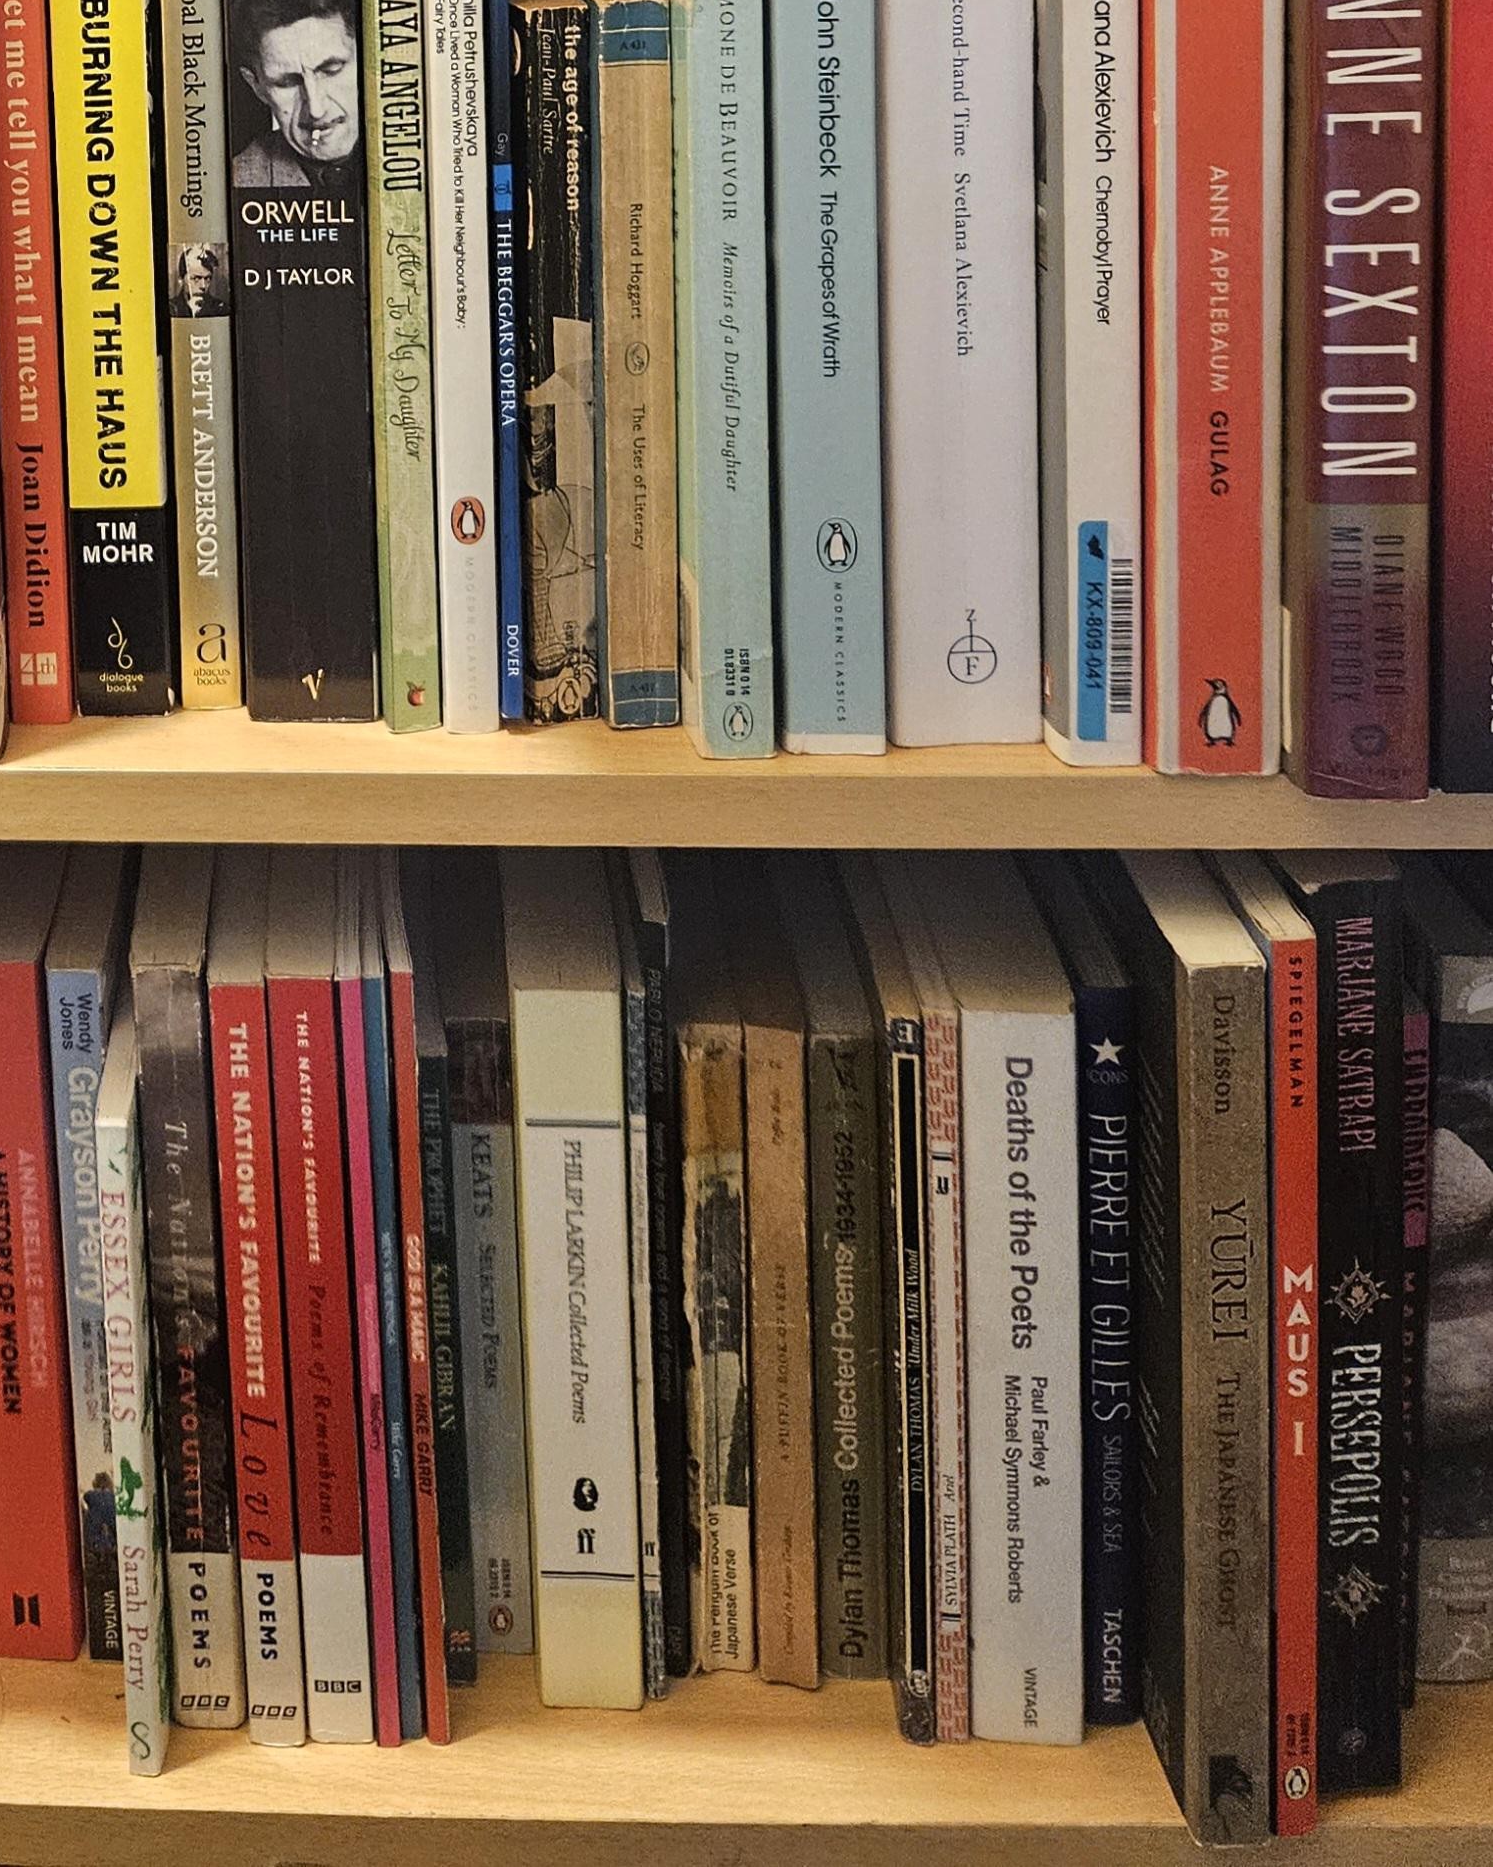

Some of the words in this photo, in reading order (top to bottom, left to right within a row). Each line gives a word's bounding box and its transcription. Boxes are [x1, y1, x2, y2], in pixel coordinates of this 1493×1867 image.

[463, 31, 480, 156] Petrushevskaya
[817, 56, 841, 177] Steinbeck
[1095, 50, 1117, 164] Alexievich
[86, 172, 119, 291] DOWN
[241, 200, 355, 226] ORWELL
[257, 227, 294, 243] THE
[301, 227, 339, 241] LIFE
[1095, 175, 1112, 268] Chernobyl
[244, 270, 260, 286] D
[265, 270, 272, 290] J
[276, 268, 355, 286] TAYLOR
[1095, 270, 1112, 326] Prayer
[92, 302, 123, 378] THE
[1321, 188, 1421, 475] SEXTON
[96, 388, 127, 490] HAUS
[1210, 411, 1229, 496] GULAG
[83, 544, 154, 563] MOHR
[97, 521, 136, 541] TIM
[99, 671, 143, 685] dialogue
[106, 682, 137, 694] books
[1335, 918, 1374, 1038] MARJANE
[1288, 957, 1303, 1109] SPIEGELMAN
[1005, 1057, 1034, 1164] Deaths
[1336, 1047, 1375, 1153] SATRAPI
[1008, 1172, 1037, 1205] of
[1009, 1210, 1037, 1257] the
[1007, 1265, 1039, 1351] Poets
[1283, 1265, 1314, 1398] MAUS
[1328, 1342, 1381, 1549] PERSEPOLIS
[123, 1545, 148, 1614] Sarah
[188, 1561, 210, 1670] POEMS
[256, 1573, 278, 1661] POEMS
[124, 1624, 148, 1692] Perry
[315, 1680, 361, 1693] BBC
[1023, 1667, 1039, 1729] VINTAGE
[1103, 1608, 1123, 1705] TASCHEN
